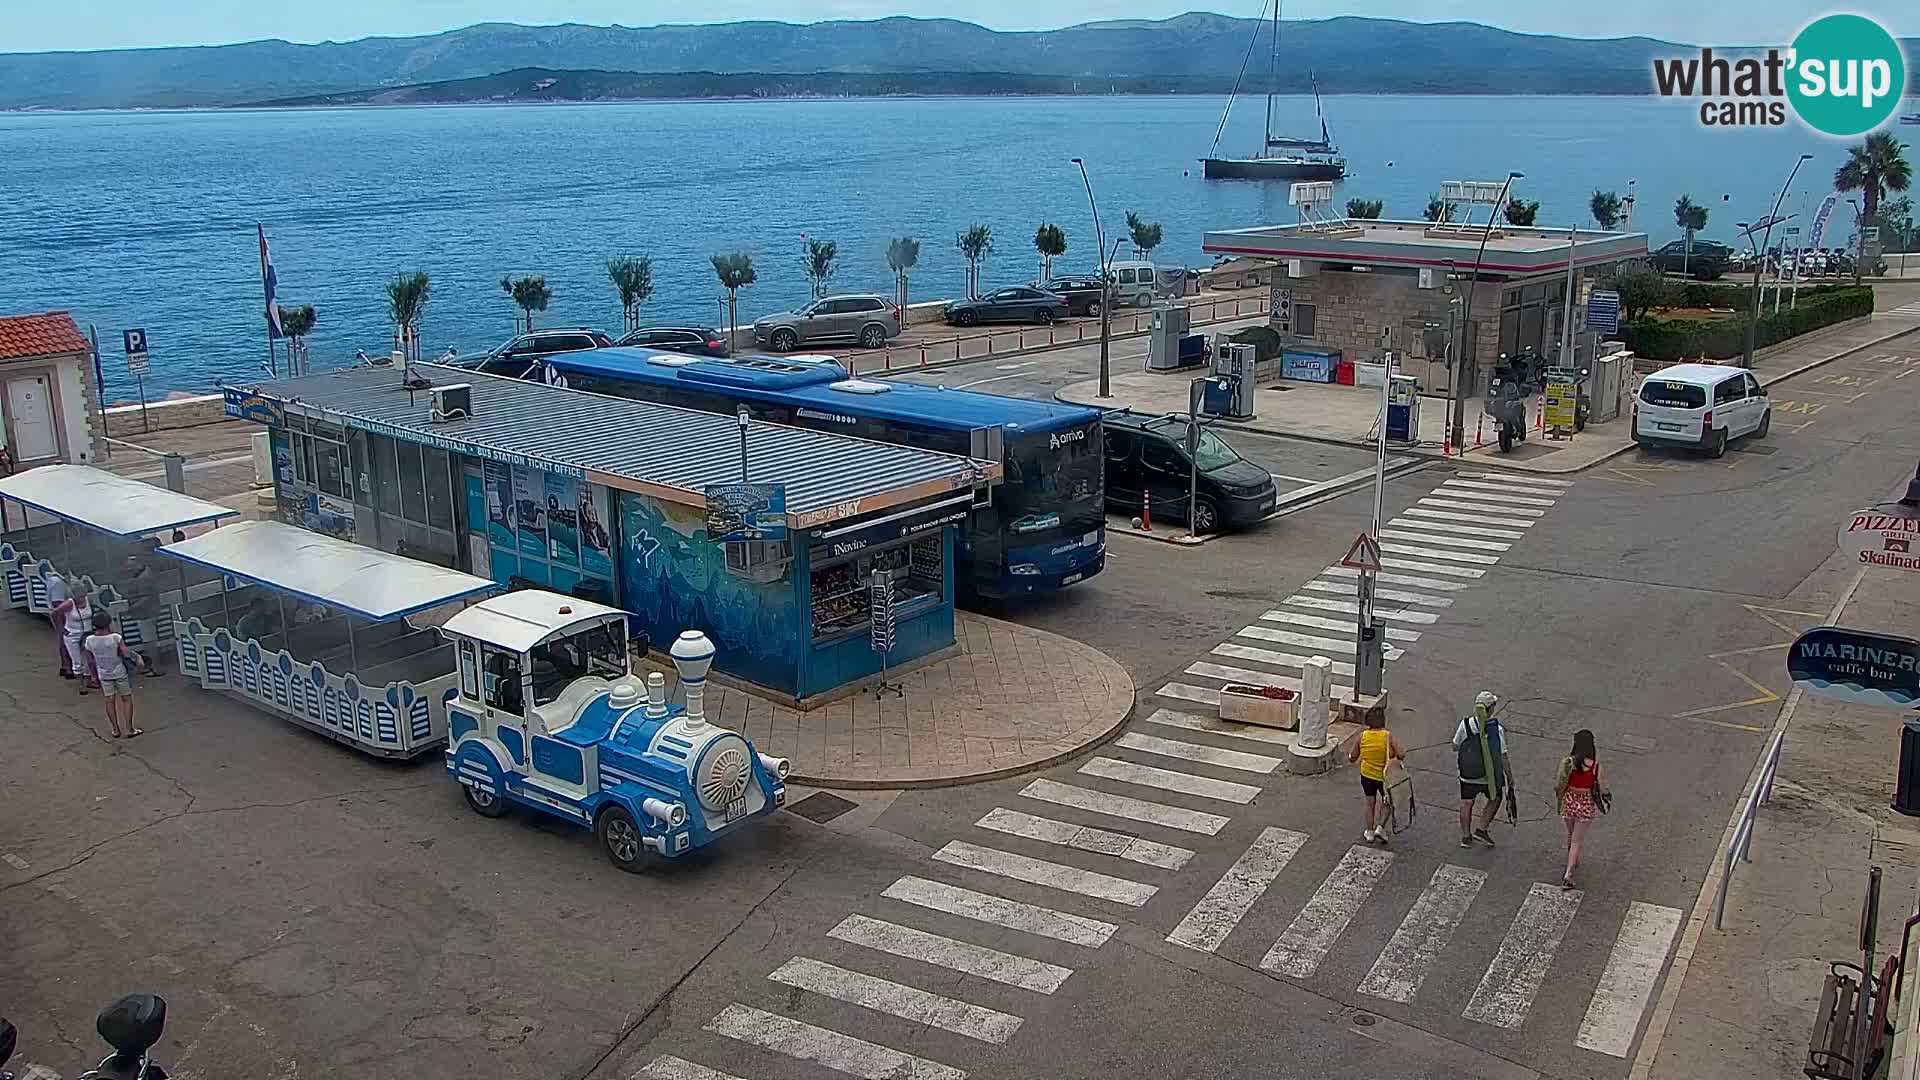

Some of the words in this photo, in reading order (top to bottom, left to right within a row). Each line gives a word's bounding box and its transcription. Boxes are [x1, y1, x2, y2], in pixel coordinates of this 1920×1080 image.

[128, 332, 141, 350] P
[1665, 382, 1684, 391] TAXI
[1060, 430, 1084, 443] arriva
[435, 438, 467, 452] POSTAJA
[477, 447, 492, 459] BUS
[493, 450, 525, 465] STATION
[527, 457, 553, 471] TICKET
[554, 464, 582, 478] OFFICE
[1881, 531, 1917, 541] GRILL
[1828, 663, 1865, 675] caffe
[1870, 666, 1897, 681] bar
